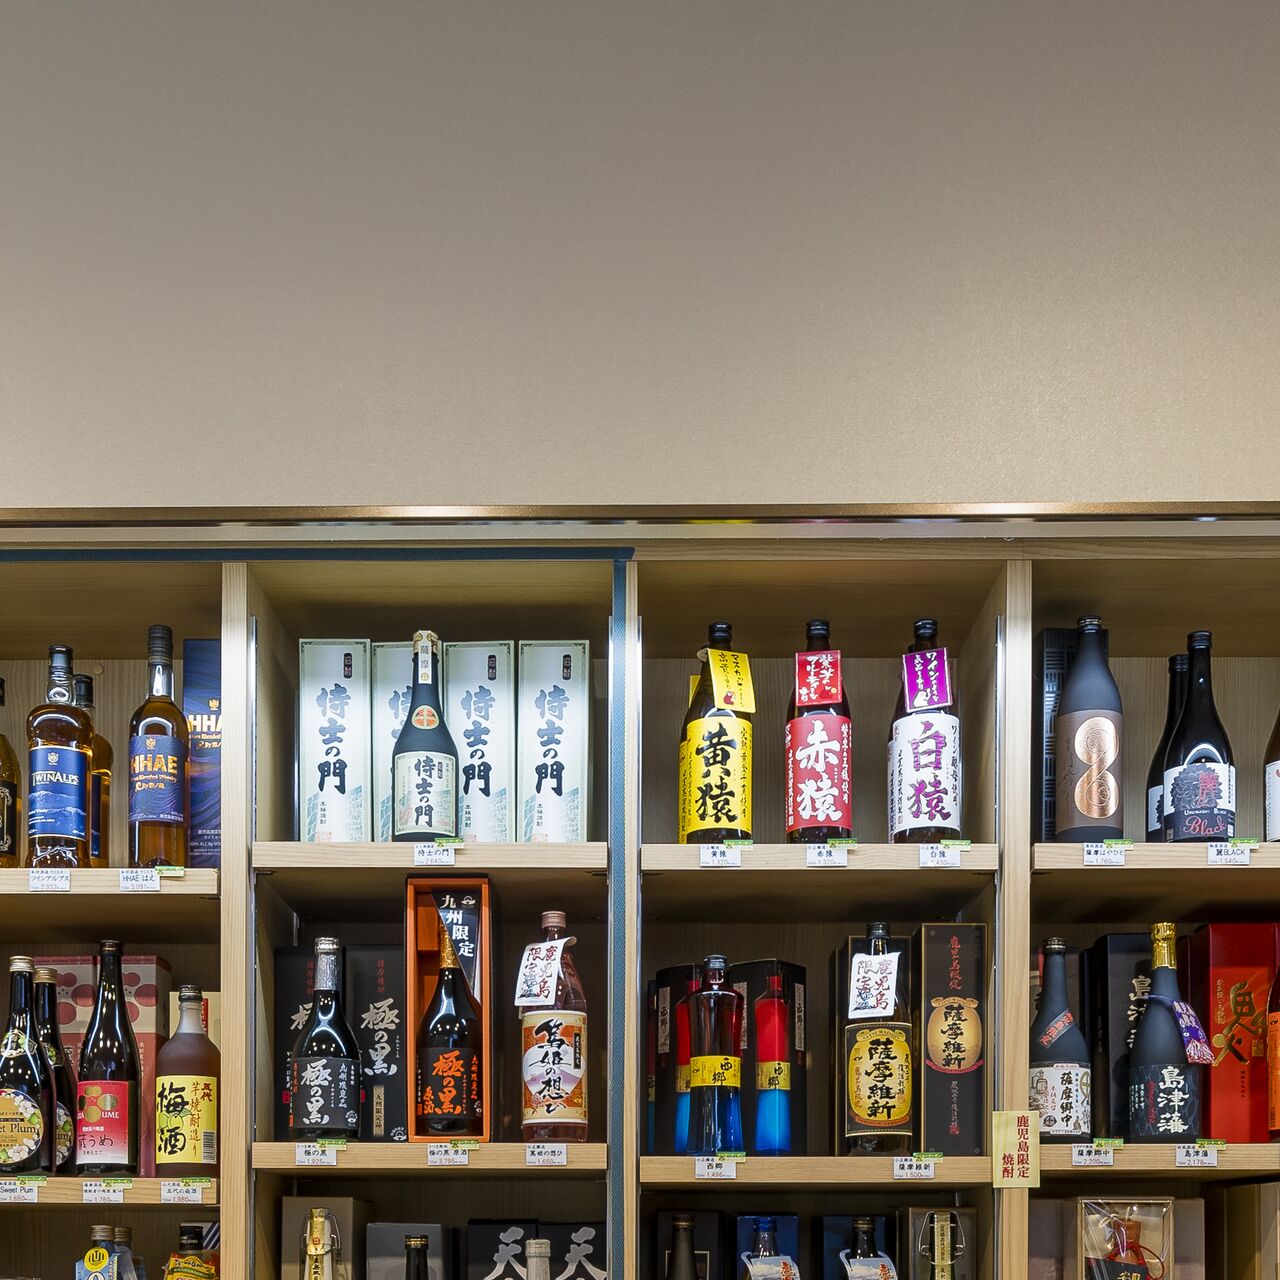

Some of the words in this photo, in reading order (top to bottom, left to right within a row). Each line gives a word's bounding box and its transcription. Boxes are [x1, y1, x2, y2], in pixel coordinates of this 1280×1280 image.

[316, 683, 351, 795] 侍士の門
[460, 685, 496, 797] 侍士の門
[535, 685, 569, 796] 侍士の門
[695, 722, 737, 823] 黄猿
[796, 720, 842, 822] 赤猿
[907, 721, 951, 822] 白猿
[415, 756, 436, 828] 侍士の門
[1183, 816, 1226, 835] Black
[440, 895, 474, 957] 九州限定
[537, 945, 556, 999] 鹿児島
[873, 959, 893, 1011] 鹿児島
[361, 997, 400, 1076] 極の黒
[941, 1004, 968, 1069] 薩摩維新
[301, 1058, 332, 1125] 極の黒
[432, 1049, 466, 1114] 極の黒
[712, 1058, 733, 1085] 西郷
[865, 1038, 897, 1119] 薩摩維新
[1157, 1066, 1189, 1133] 島津藩
[10, 1124, 36, 1134] Plum
[157, 1082, 189, 1155] 梅酒
[189, 1081, 202, 1156] 芋焼酎造り
[1017, 1115, 1029, 1178] 鹿児島限定
[1002, 1153, 1014, 1178] 焼酎
